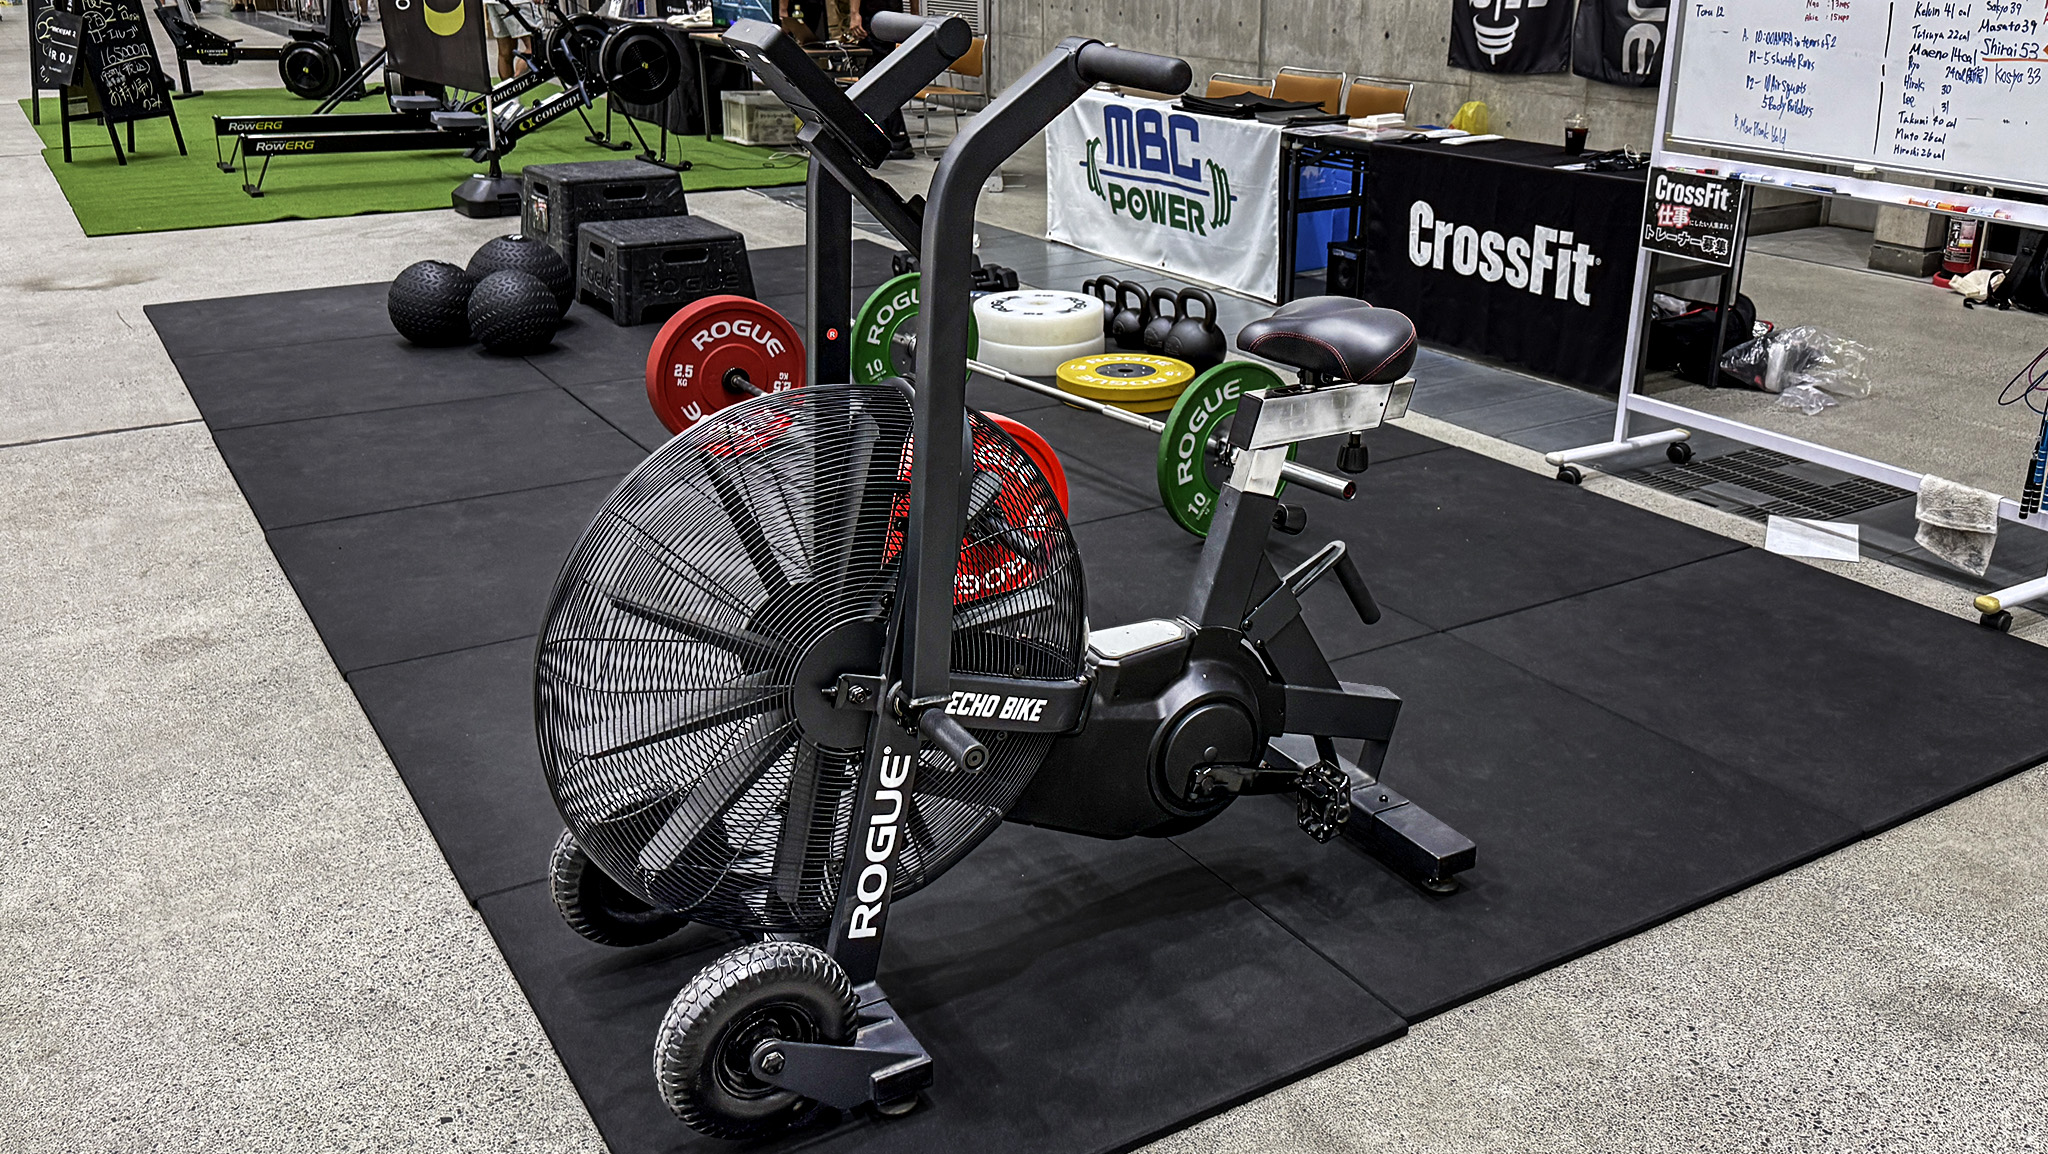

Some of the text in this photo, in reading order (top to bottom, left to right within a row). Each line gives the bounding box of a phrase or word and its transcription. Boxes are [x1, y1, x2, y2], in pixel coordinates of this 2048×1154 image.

[1716, 6, 1725, 17] 12
[2010, 2, 2022, 15] 39
[1978, 19, 2038, 35] Masato 39
[1831, 36, 1838, 48] 2
[1909, 43, 1949, 60] Maeno
[1980, 38, 2040, 60] Shirai 53
[2027, 67, 2042, 85] 33
[492, 74, 537, 103] oncept 2
[1941, 84, 1952, 95] 30
[535, 93, 581, 122] concept
[1104, 104, 1202, 182] MBC
[1655, 174, 1731, 212] CrossFit
[1107, 182, 1207, 237] POWER
[1409, 200, 1596, 306] CrossFit
[866, 288, 920, 346] ROGU
[691, 320, 786, 358] ROGUE
[673, 363, 694, 378] 2.5
[865, 358, 883, 375] 10
[677, 378, 688, 387] KG
[1177, 378, 1240, 486] ROGUE
[1188, 492, 1206, 514] 10
[945, 691, 1048, 722] ECHO BIKE
[848, 754, 911, 939] ROGUE
